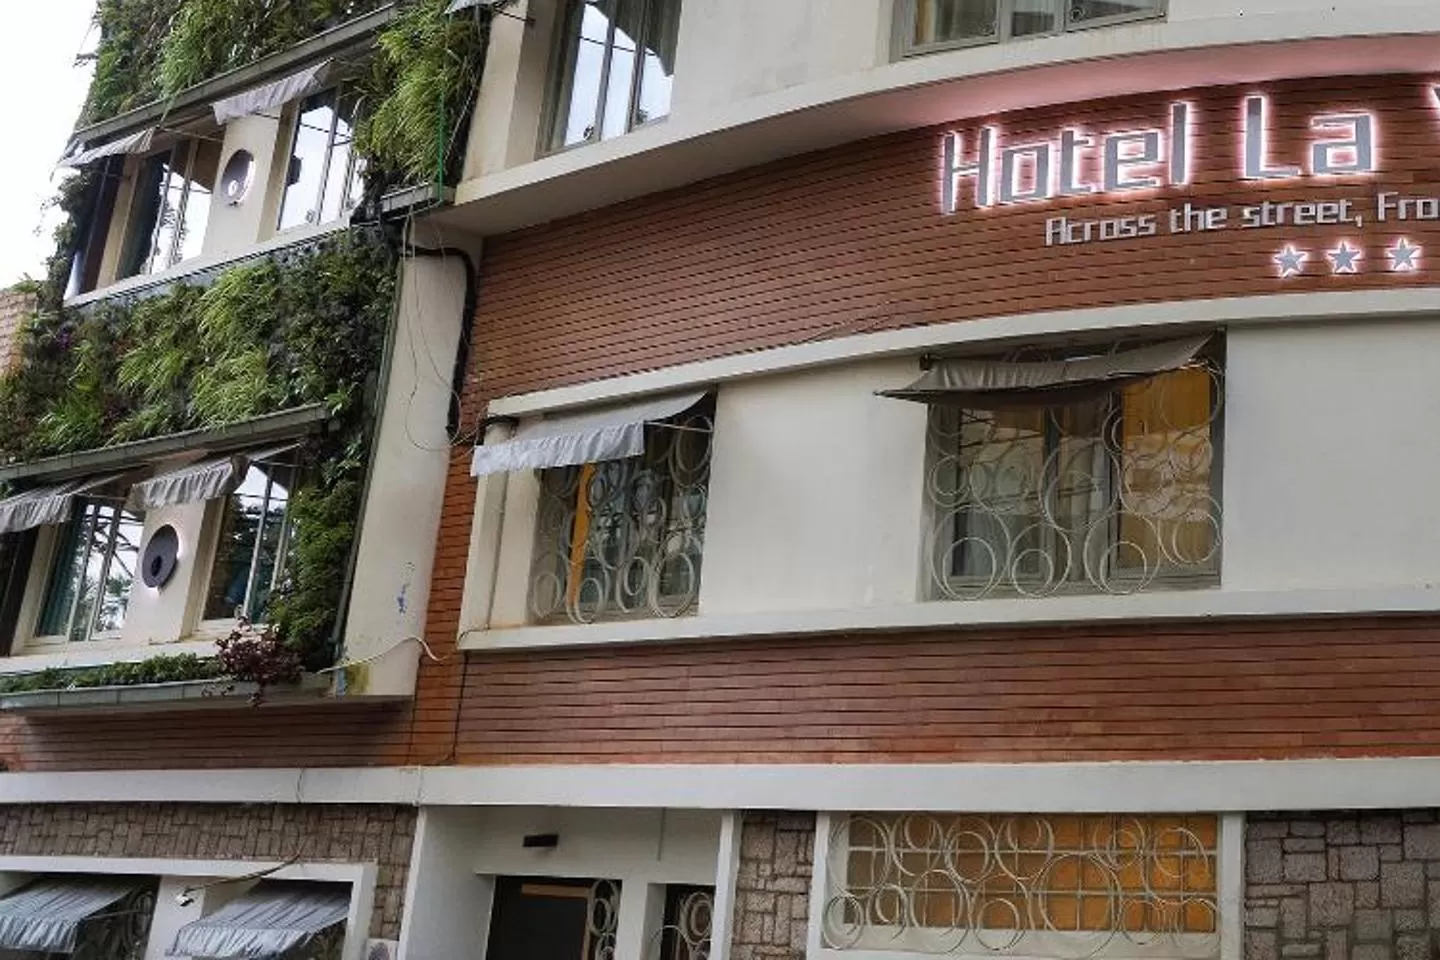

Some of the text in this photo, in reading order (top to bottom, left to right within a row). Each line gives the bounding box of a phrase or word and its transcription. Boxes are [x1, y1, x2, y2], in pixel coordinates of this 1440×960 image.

[940, 101, 1192, 216] Hotel
[1244, 94, 1375, 179] La
[1045, 216, 1156, 246] Across
[1169, 203, 1229, 230] the
[1241, 199, 1363, 228] street,
